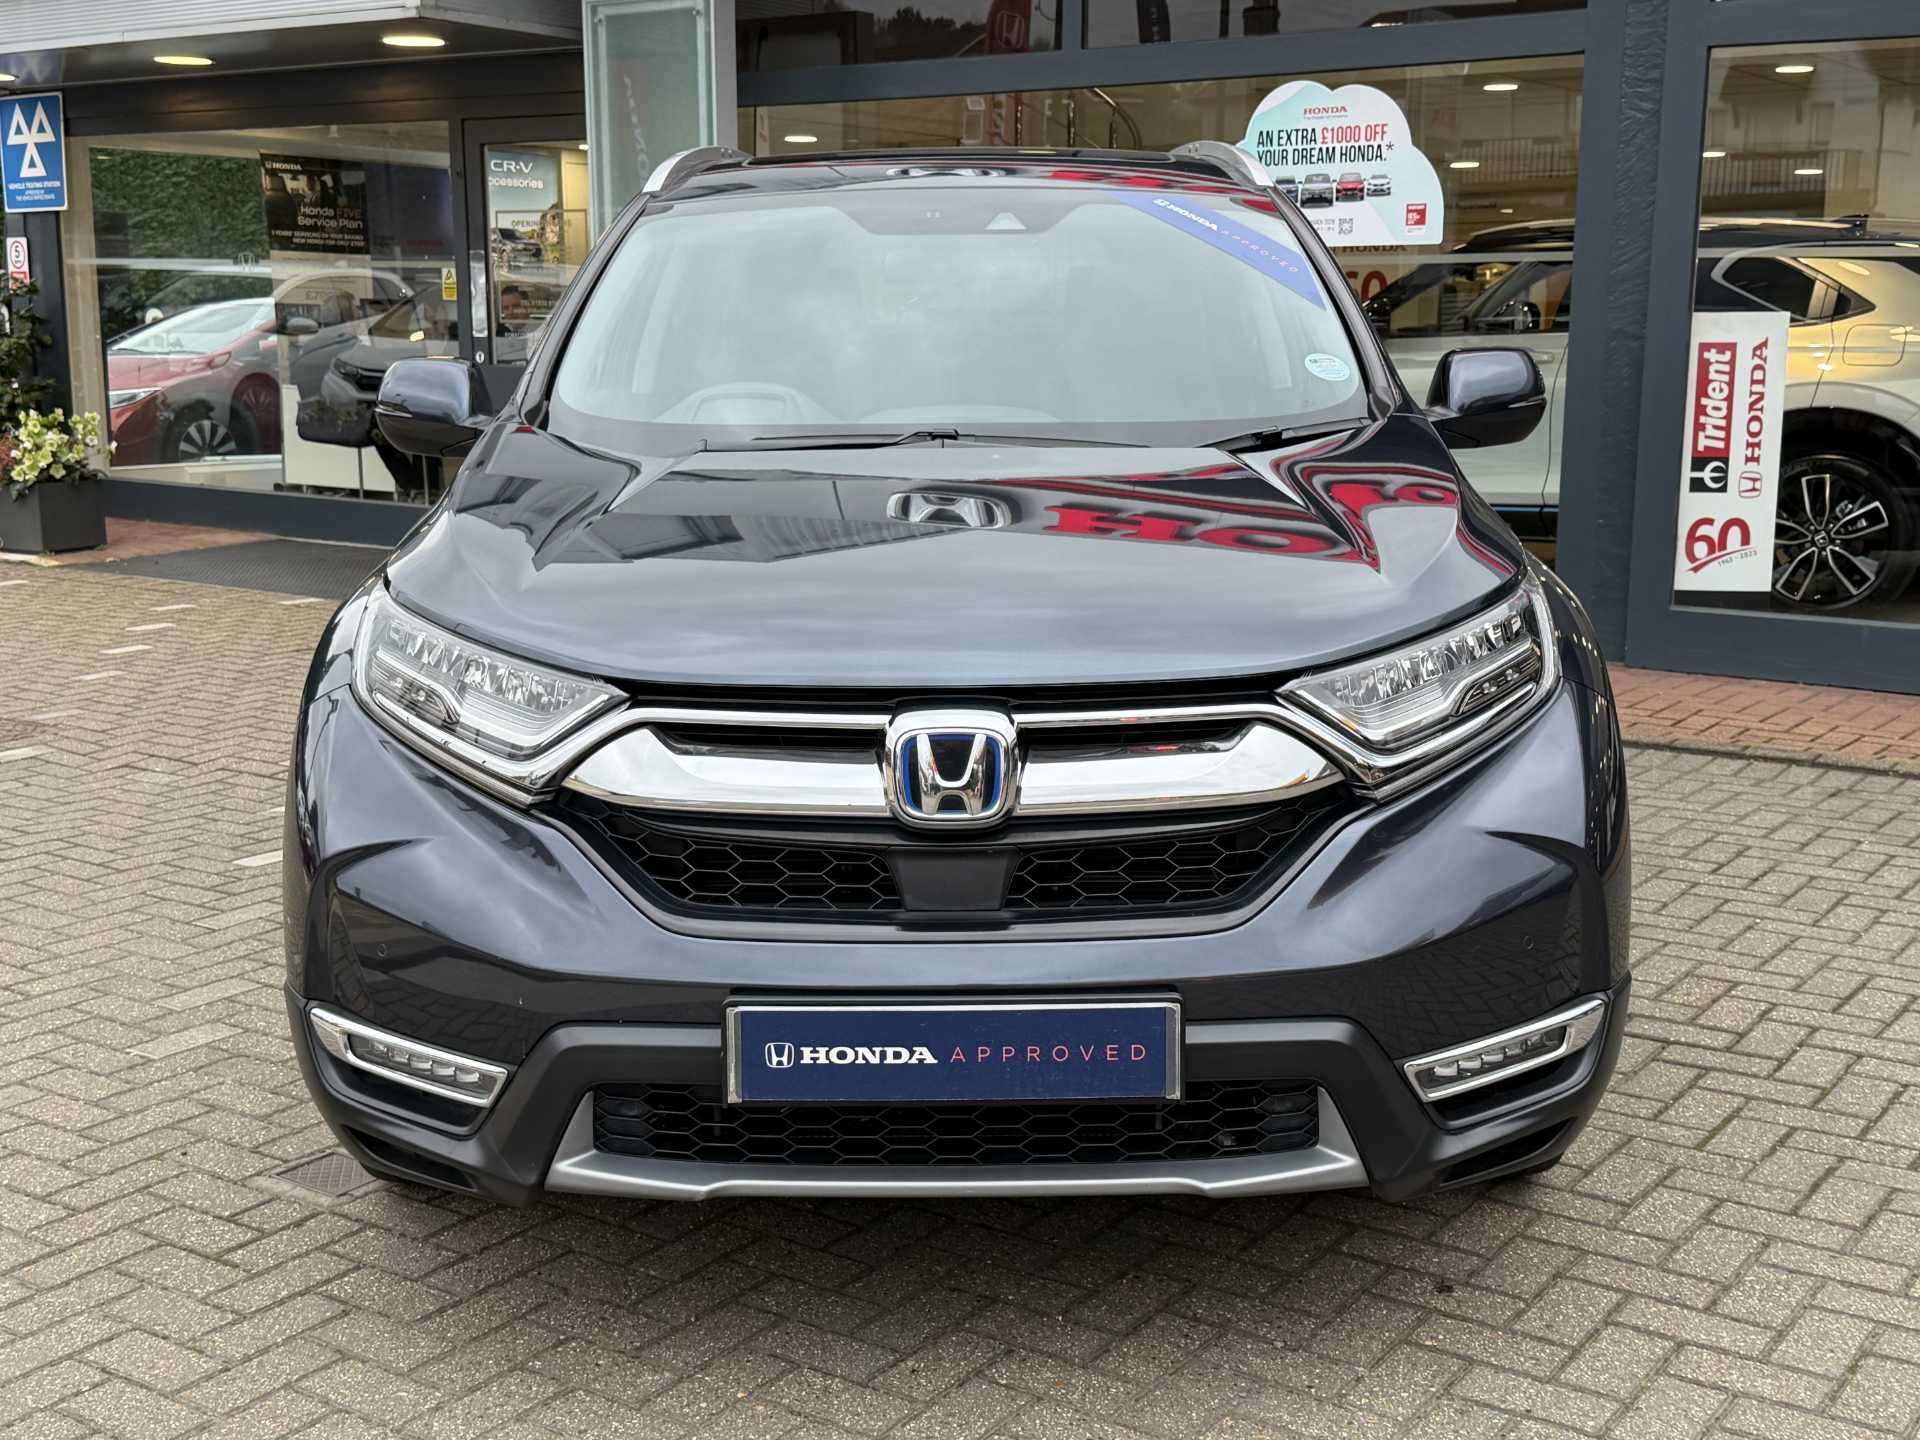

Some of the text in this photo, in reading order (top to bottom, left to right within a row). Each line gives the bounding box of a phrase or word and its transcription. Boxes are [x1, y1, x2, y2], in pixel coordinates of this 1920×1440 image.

[1304, 106, 1347, 115] HONDA
[1257, 123, 1388, 148] AN EXTRA £1000 OFF
[272, 162, 302, 171] HONDA
[1257, 149, 1289, 167] YOUR
[1292, 146, 1336, 166] DREAM
[297, 216, 363, 229] Service Plan
[299, 206, 362, 219] Honda FIVE
[1167, 204, 1300, 273] HONDA APPROVED
[14, 244, 21, 259] 5
[1697, 348, 1731, 452] Trident
[1744, 337, 1769, 467] HONDA
[1685, 516, 1751, 567] 60
[800, 1043, 1146, 1065] HONDA APPROVED
